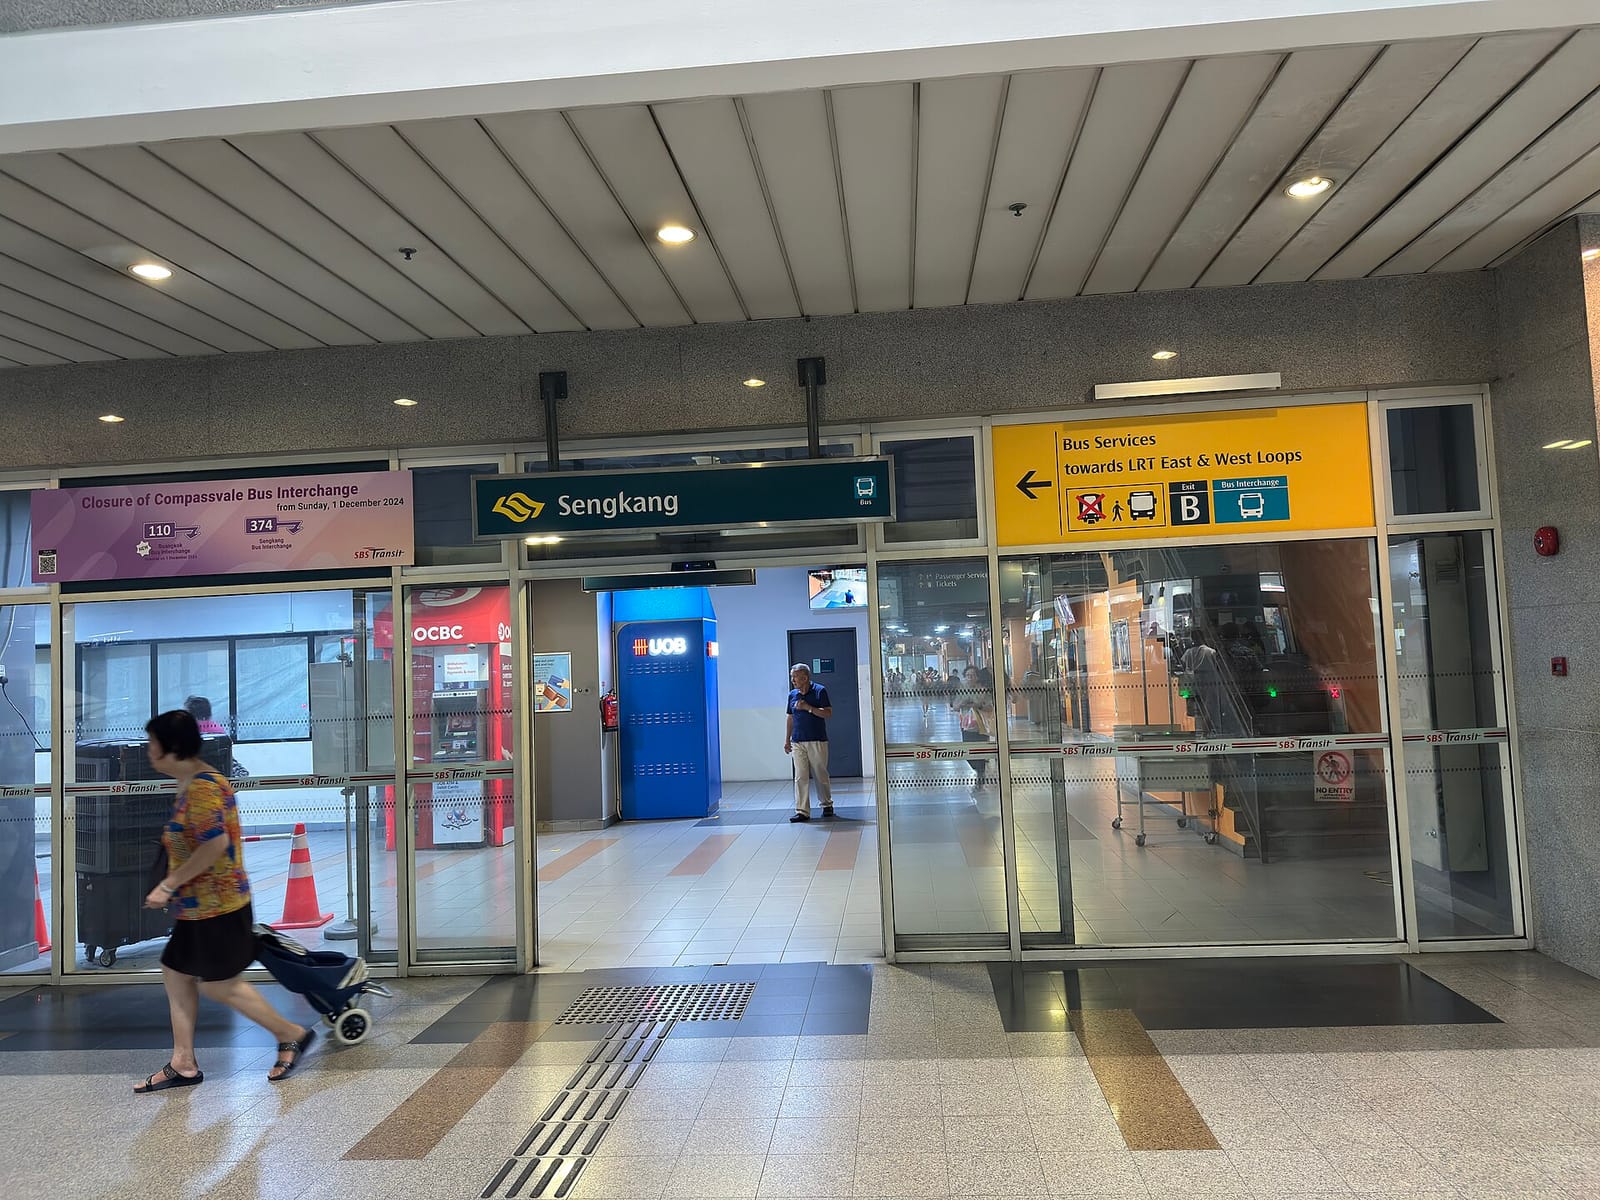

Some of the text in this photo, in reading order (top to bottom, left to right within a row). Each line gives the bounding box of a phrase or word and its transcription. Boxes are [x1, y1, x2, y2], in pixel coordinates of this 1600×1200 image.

[1062, 433, 1156, 451] Bus Services
[1064, 450, 1302, 475] towards LRT East & West Loops
[1181, 483, 1195, 491] Exit
[1221, 479, 1280, 489] Bus Interchange
[81, 483, 359, 509] Closure of Compassvale Bus Interchange
[276, 497, 404, 512] from Sunday, 1 December 2024
[558, 490, 679, 519] Sengkang
[1180, 495, 1201, 522] B
[148, 524, 171, 537] 110
[250, 519, 273, 532] 374
[354, 548, 404, 559] SBS Transit
[935, 573, 966, 581] Passenger
[936, 580, 957, 588] Tickets
[413, 625, 463, 641] OCBC
[649, 637, 687, 656] UOB
[1426, 731, 1481, 743] SBS Transit
[1175, 741, 1229, 753] SBS Transit
[1278, 738, 1332, 749] SBS Transit
[916, 748, 966, 759] SBS Transit
[1062, 745, 1114, 756] SBS Transit
[434, 768, 484, 780] SBS Transit
[299, 775, 347, 786] SBS Transit
[1, 786, 31, 797] Transit
[111, 782, 158, 793] SBS Transit
